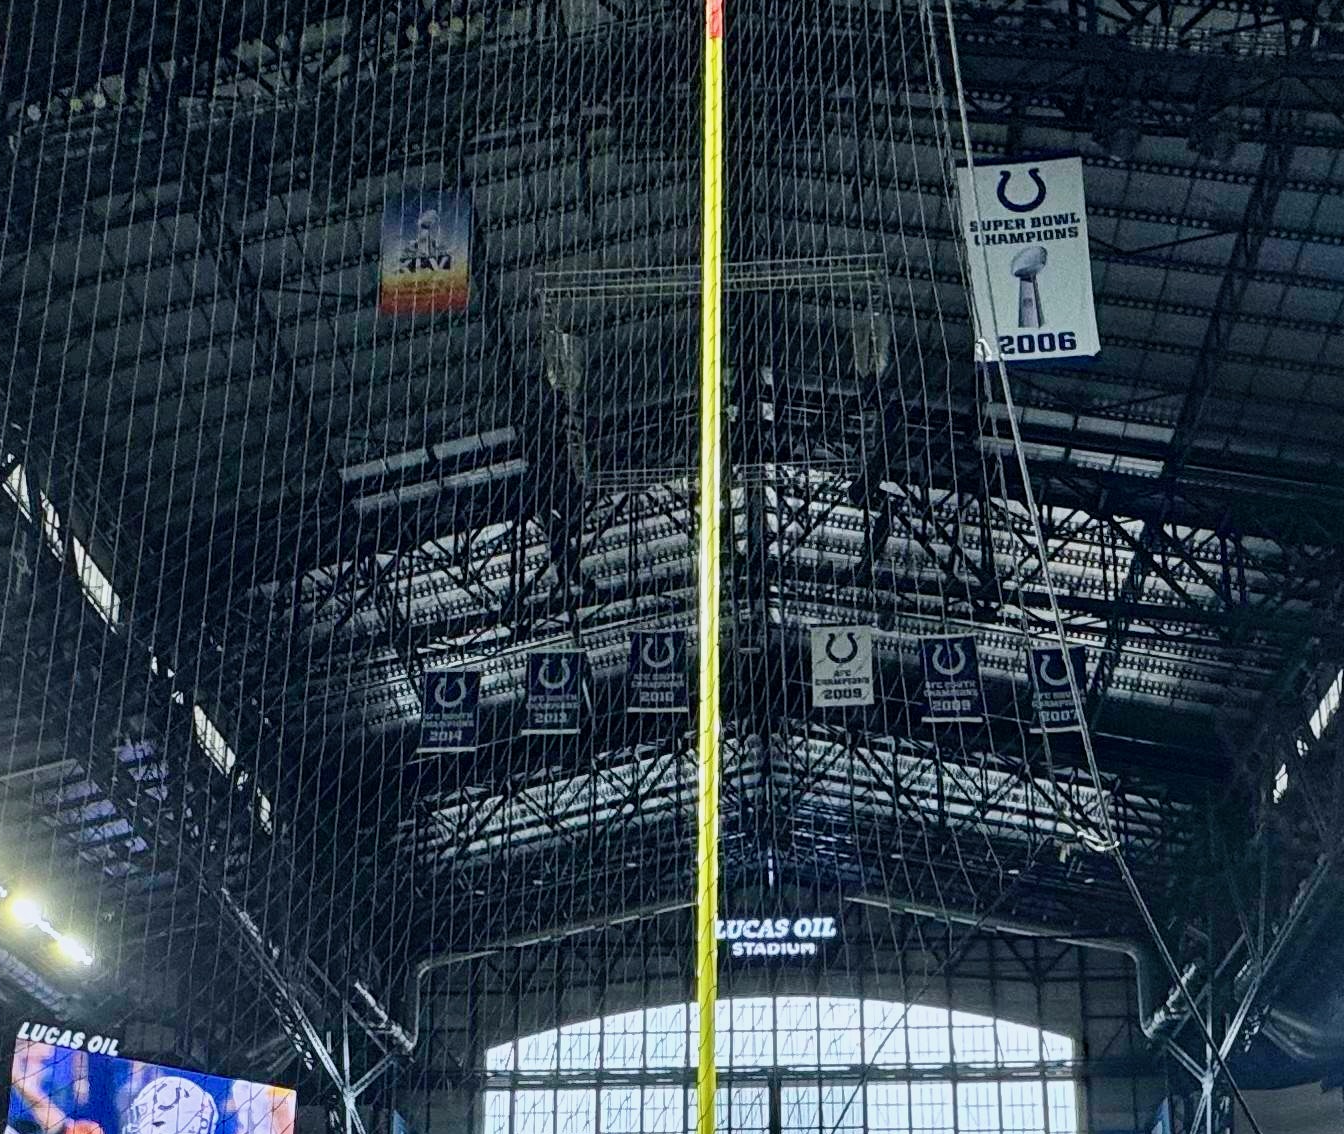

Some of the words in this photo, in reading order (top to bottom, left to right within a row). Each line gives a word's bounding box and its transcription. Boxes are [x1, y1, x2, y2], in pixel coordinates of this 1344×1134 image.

[970, 217, 1026, 232] SUPER
[1030, 212, 1081, 229] BOWL
[974, 226, 1079, 246] CHAMPIONS
[999, 331, 1077, 355] 2006
[824, 688, 862, 700] 2009
[715, 918, 790, 939] LUCAS
[793, 917, 837, 938] OIL
[732, 942, 816, 956] STADIUM
[17, 1022, 86, 1051] LUCAS
[87, 1034, 121, 1057] OIL
